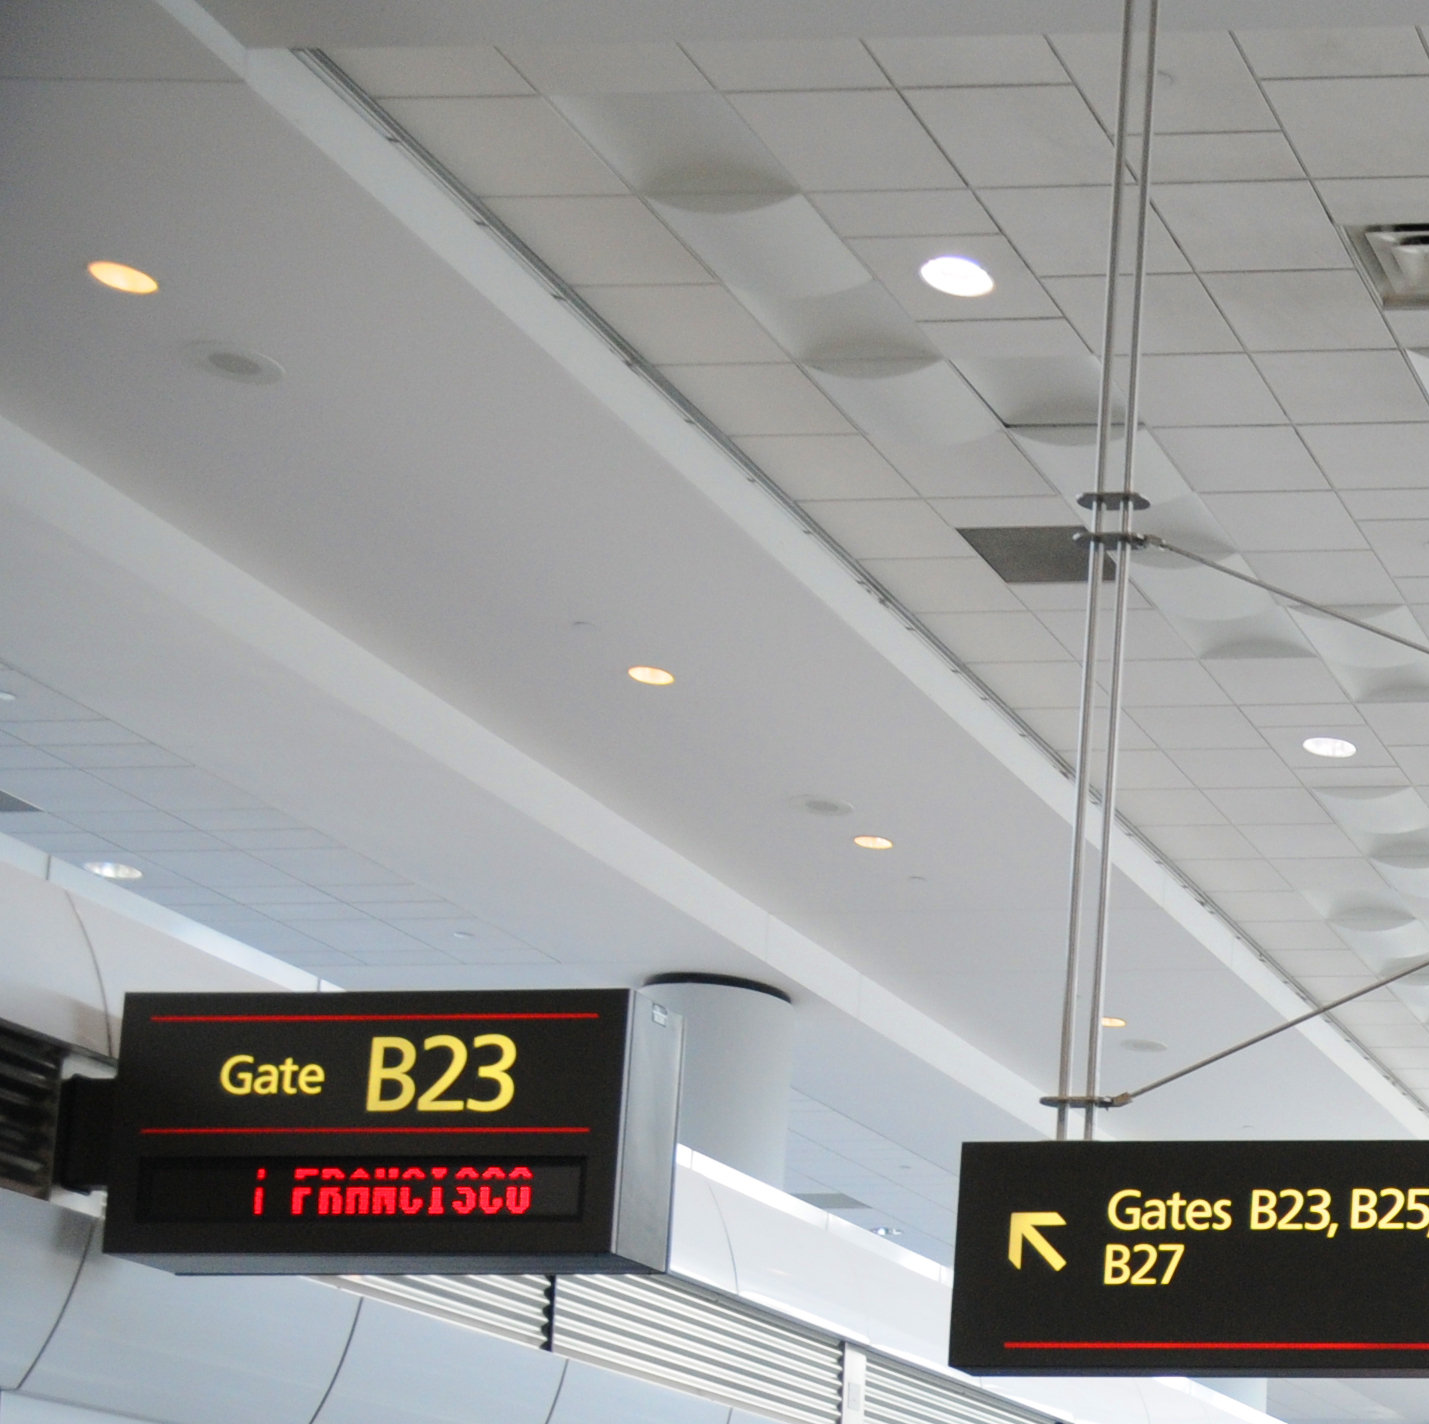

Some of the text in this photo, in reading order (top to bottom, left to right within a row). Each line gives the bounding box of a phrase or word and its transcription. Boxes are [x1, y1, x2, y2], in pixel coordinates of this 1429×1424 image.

[220, 1034, 516, 1112] Gate B23
[291, 1167, 534, 1215] FRANCISCO
[1108, 1189, 1232, 1230] Gates
[1250, 1189, 1338, 1238] B23,
[1104, 1243, 1185, 1285] B27
